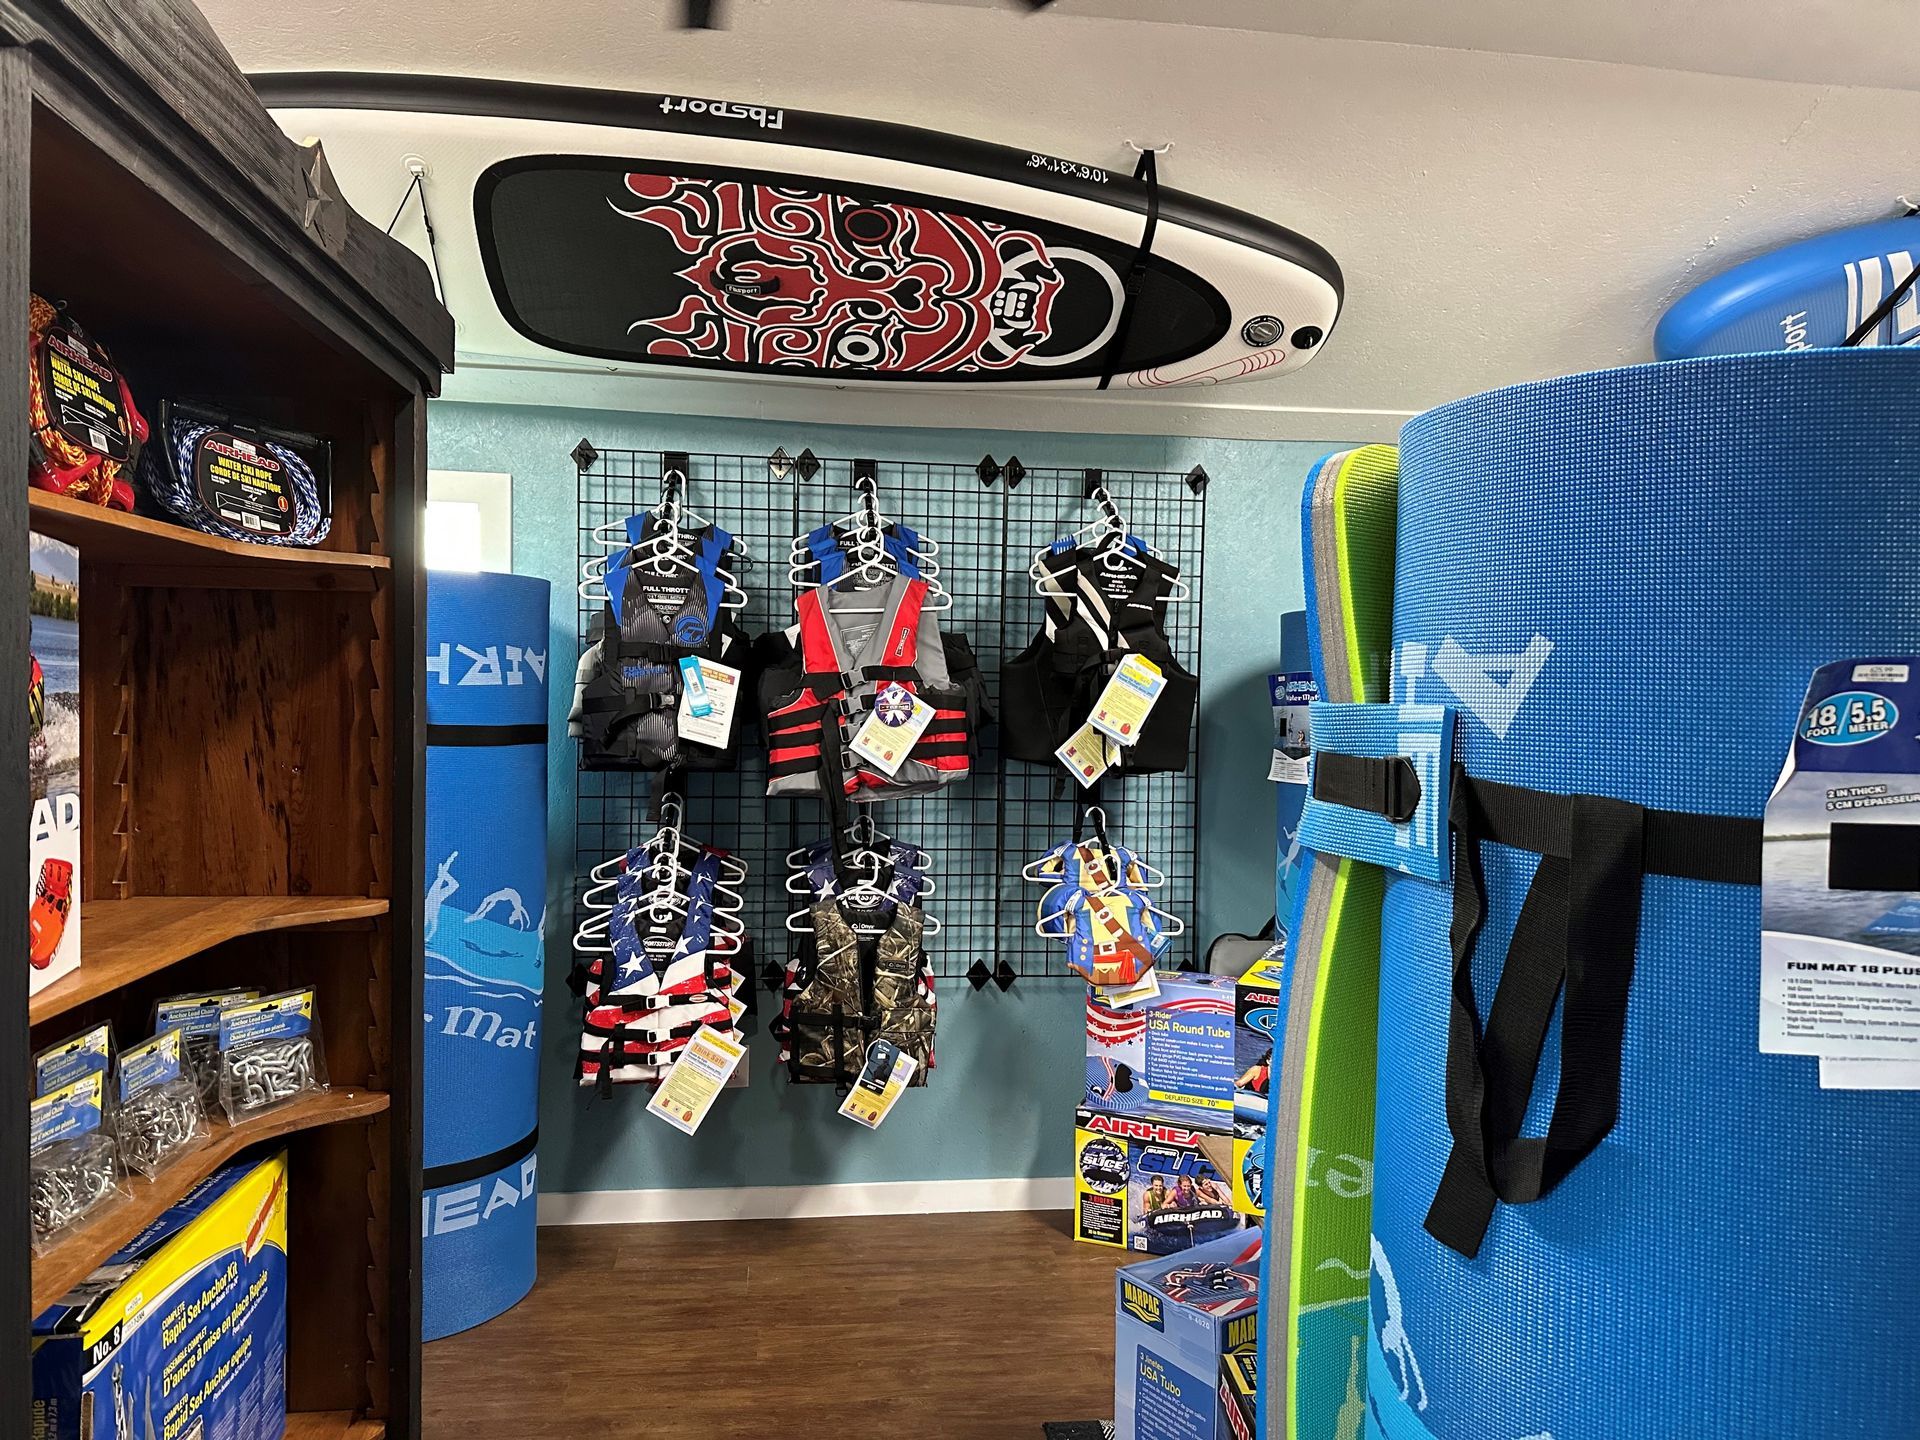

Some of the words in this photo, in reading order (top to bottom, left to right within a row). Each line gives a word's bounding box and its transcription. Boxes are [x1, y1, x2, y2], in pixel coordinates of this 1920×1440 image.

[47, 334, 113, 382] AIRHEAD
[51, 356, 73, 378] WATER
[204, 440, 281, 471] AIRHEAD
[217, 456, 242, 471] WATER
[242, 463, 255, 476] SKI
[255, 466, 273, 481] ROPE
[210, 464, 232, 479] CORDE
[231, 471, 241, 481] DE
[240, 474, 252, 485] SKI
[252, 477, 282, 493] NAUTIQUE
[1806, 725, 1838, 739] FOOT
[1847, 720, 1890, 734] METER
[1808, 704, 1837, 729] 18
[1836, 789, 1848, 797] IN
[1836, 801, 1852, 809] CM
[1786, 961, 1818, 971] FUN
[1821, 963, 1857, 973] MAT
[1860, 965, 1879, 974] 18
[1149, 1019, 1170, 1031] USA
[1172, 1022, 1204, 1036] Round
[1206, 1026, 1231, 1039] Tube
[1164, 1093, 1191, 1103] DEFLATED
[1191, 1097, 1203, 1105] SIZE
[422, 1152, 538, 1238] EAD
[1154, 1210, 1223, 1225] AIRHEAD
[162, 1312, 187, 1349] Rapid
[187, 1299, 201, 1324] Set
[201, 1275, 228, 1311] Anchor
[227, 1260, 238, 1284] Kit
[1123, 1280, 1161, 1315] MARPAC
[162, 1301, 186, 1331] COMPLETE
[1227, 1313, 1257, 1348] MAR
[93, 1340, 113, 1366] No.
[113, 1325, 121, 1346] 8
[163, 1353, 197, 1398] D'ancre
[202, 1326, 221, 1357] mise
[221, 1313, 231, 1335] en
[231, 1297, 250, 1327] place
[1140, 1362, 1159, 1384] USA
[1160, 1374, 1181, 1397] Tubo
[163, 1405, 188, 1440] Rapid
[189, 1390, 203, 1415] Set
[203, 1362, 231, 1401] Anchor
